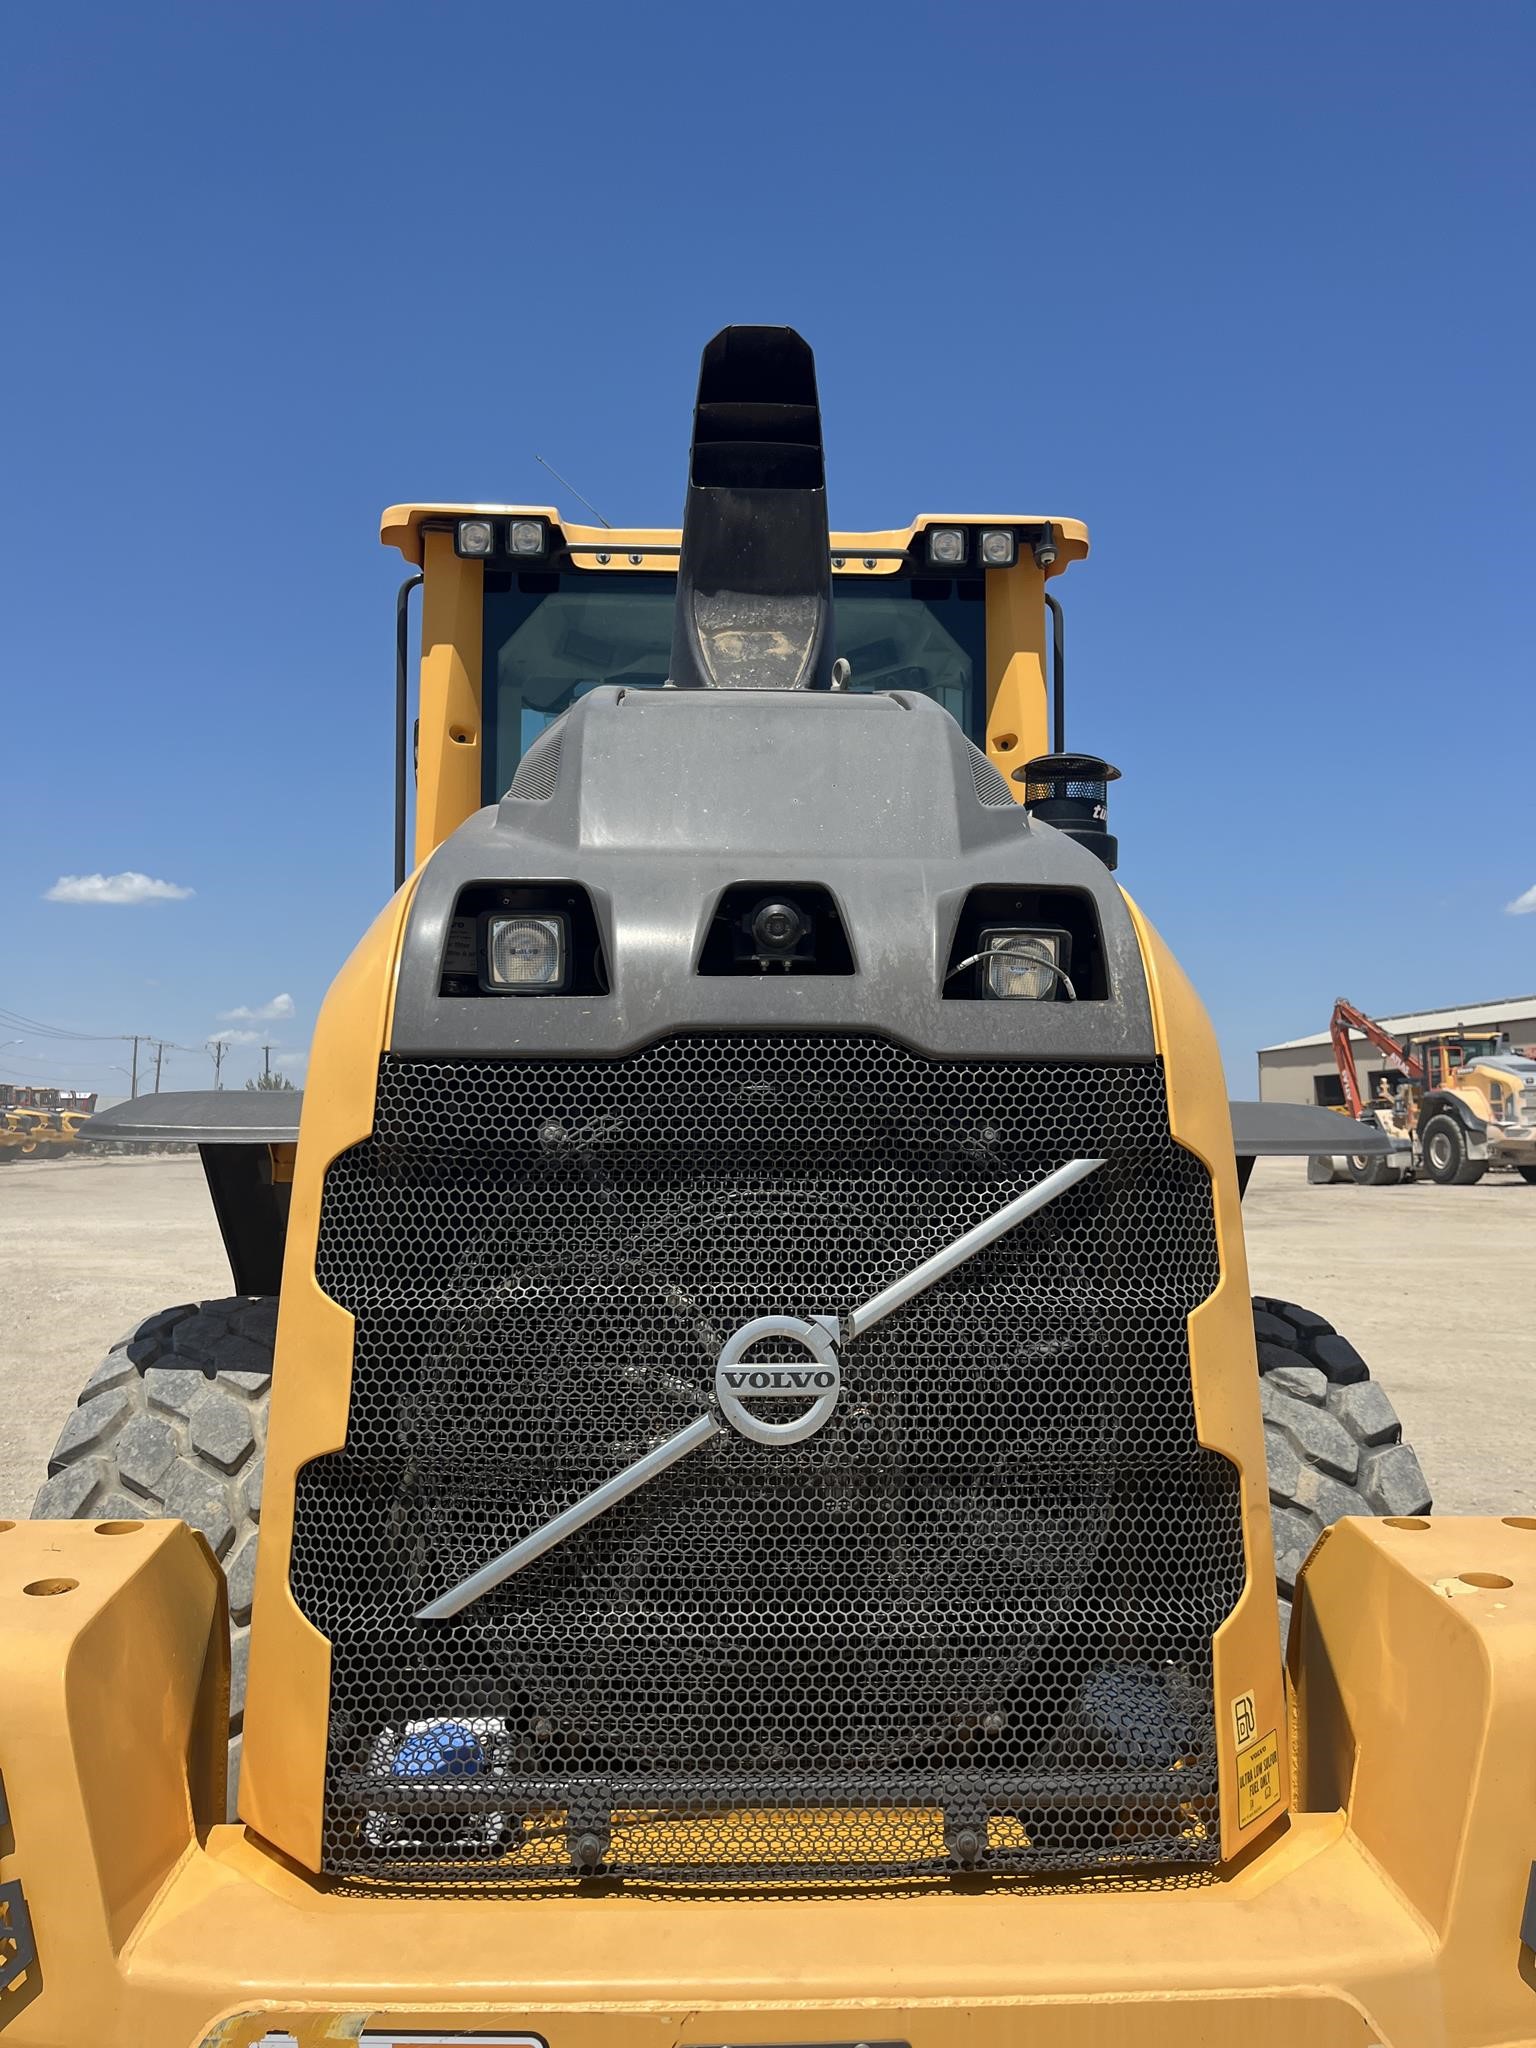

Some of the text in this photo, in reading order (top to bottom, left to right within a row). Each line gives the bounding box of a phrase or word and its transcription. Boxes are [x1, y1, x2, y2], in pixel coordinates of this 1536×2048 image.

[721, 1371, 836, 1389] VOLVO
[1250, 1746, 1267, 1761] VOLVO
[1239, 1750, 1277, 1789] ULTRA LOW SULFUR
[1249, 1771, 1270, 1797] FUEL ONLY
